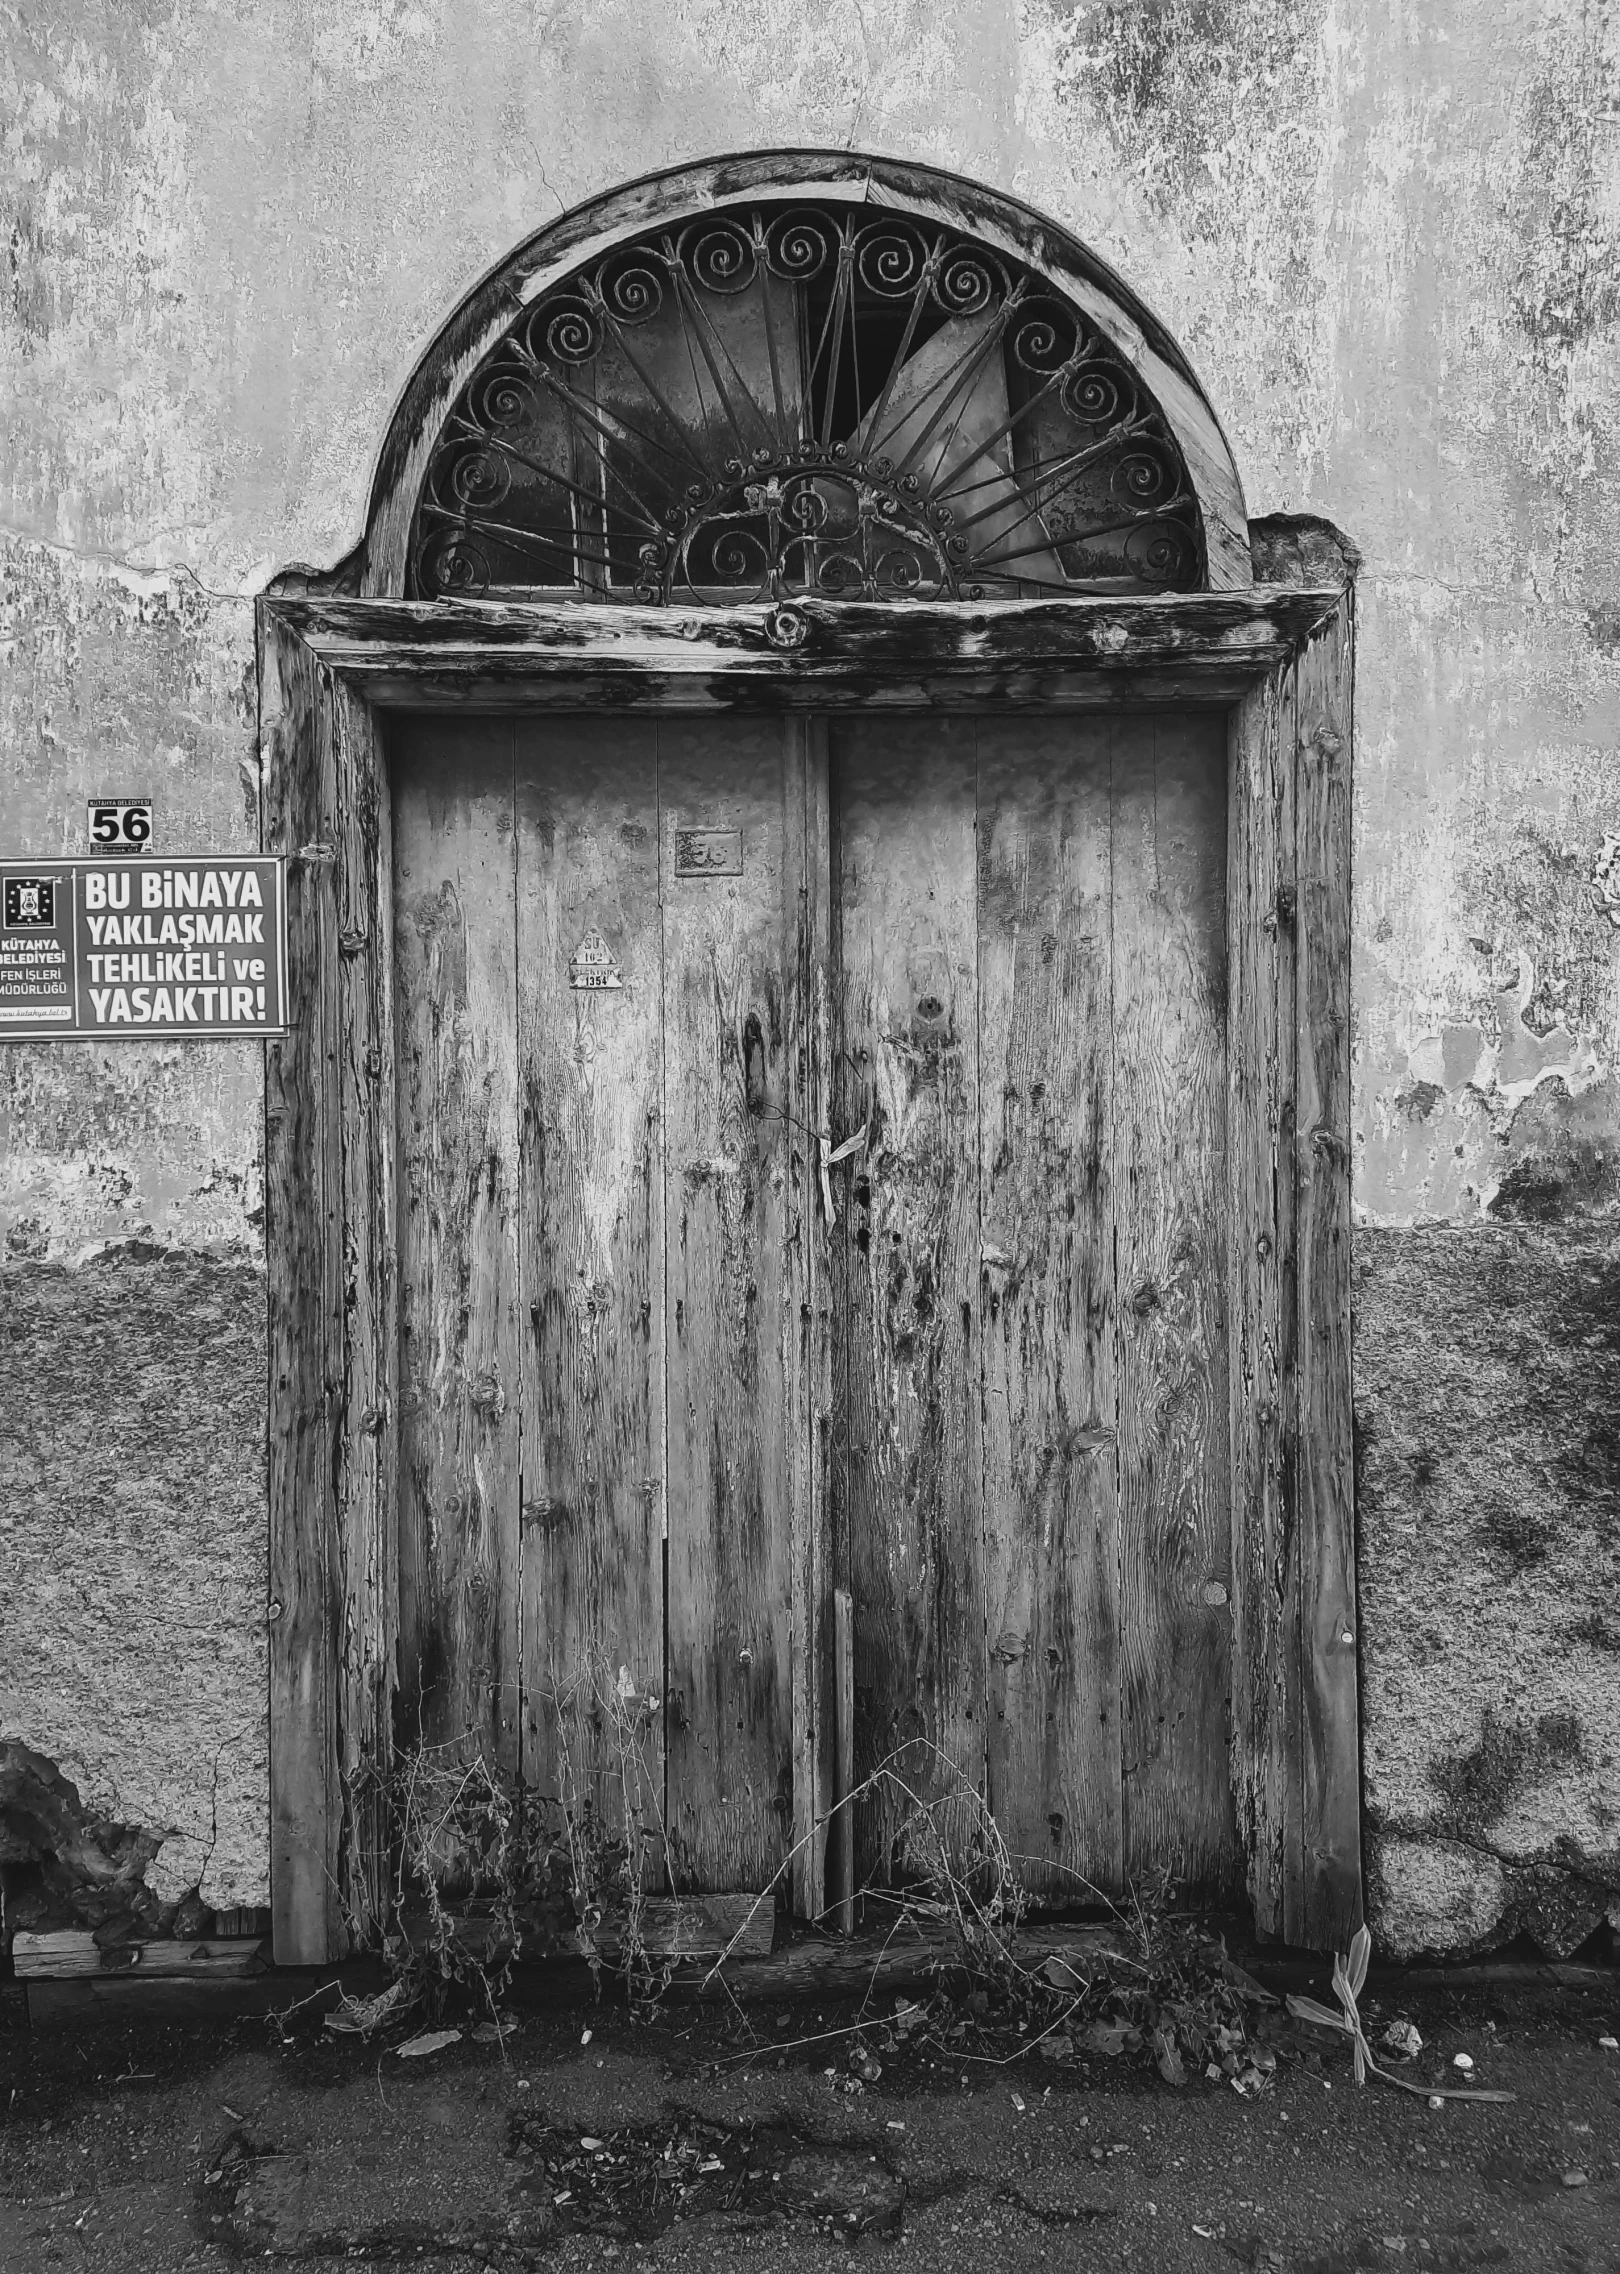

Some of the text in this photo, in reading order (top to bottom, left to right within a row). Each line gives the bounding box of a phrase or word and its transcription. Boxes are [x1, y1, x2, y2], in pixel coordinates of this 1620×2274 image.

[92, 807, 150, 842] 56
[85, 872, 130, 909] BU
[1, 936, 60, 951] KÜTAHYA
[86, 913, 265, 951] YAKLAŞMAK
[585, 937, 601, 949] SU
[1, 967, 61, 982] FEN İŞLERİ
[232, 958, 266, 981] ve
[586, 975, 608, 986] 1354
[88, 986, 266, 1023] YASAKTIR!
